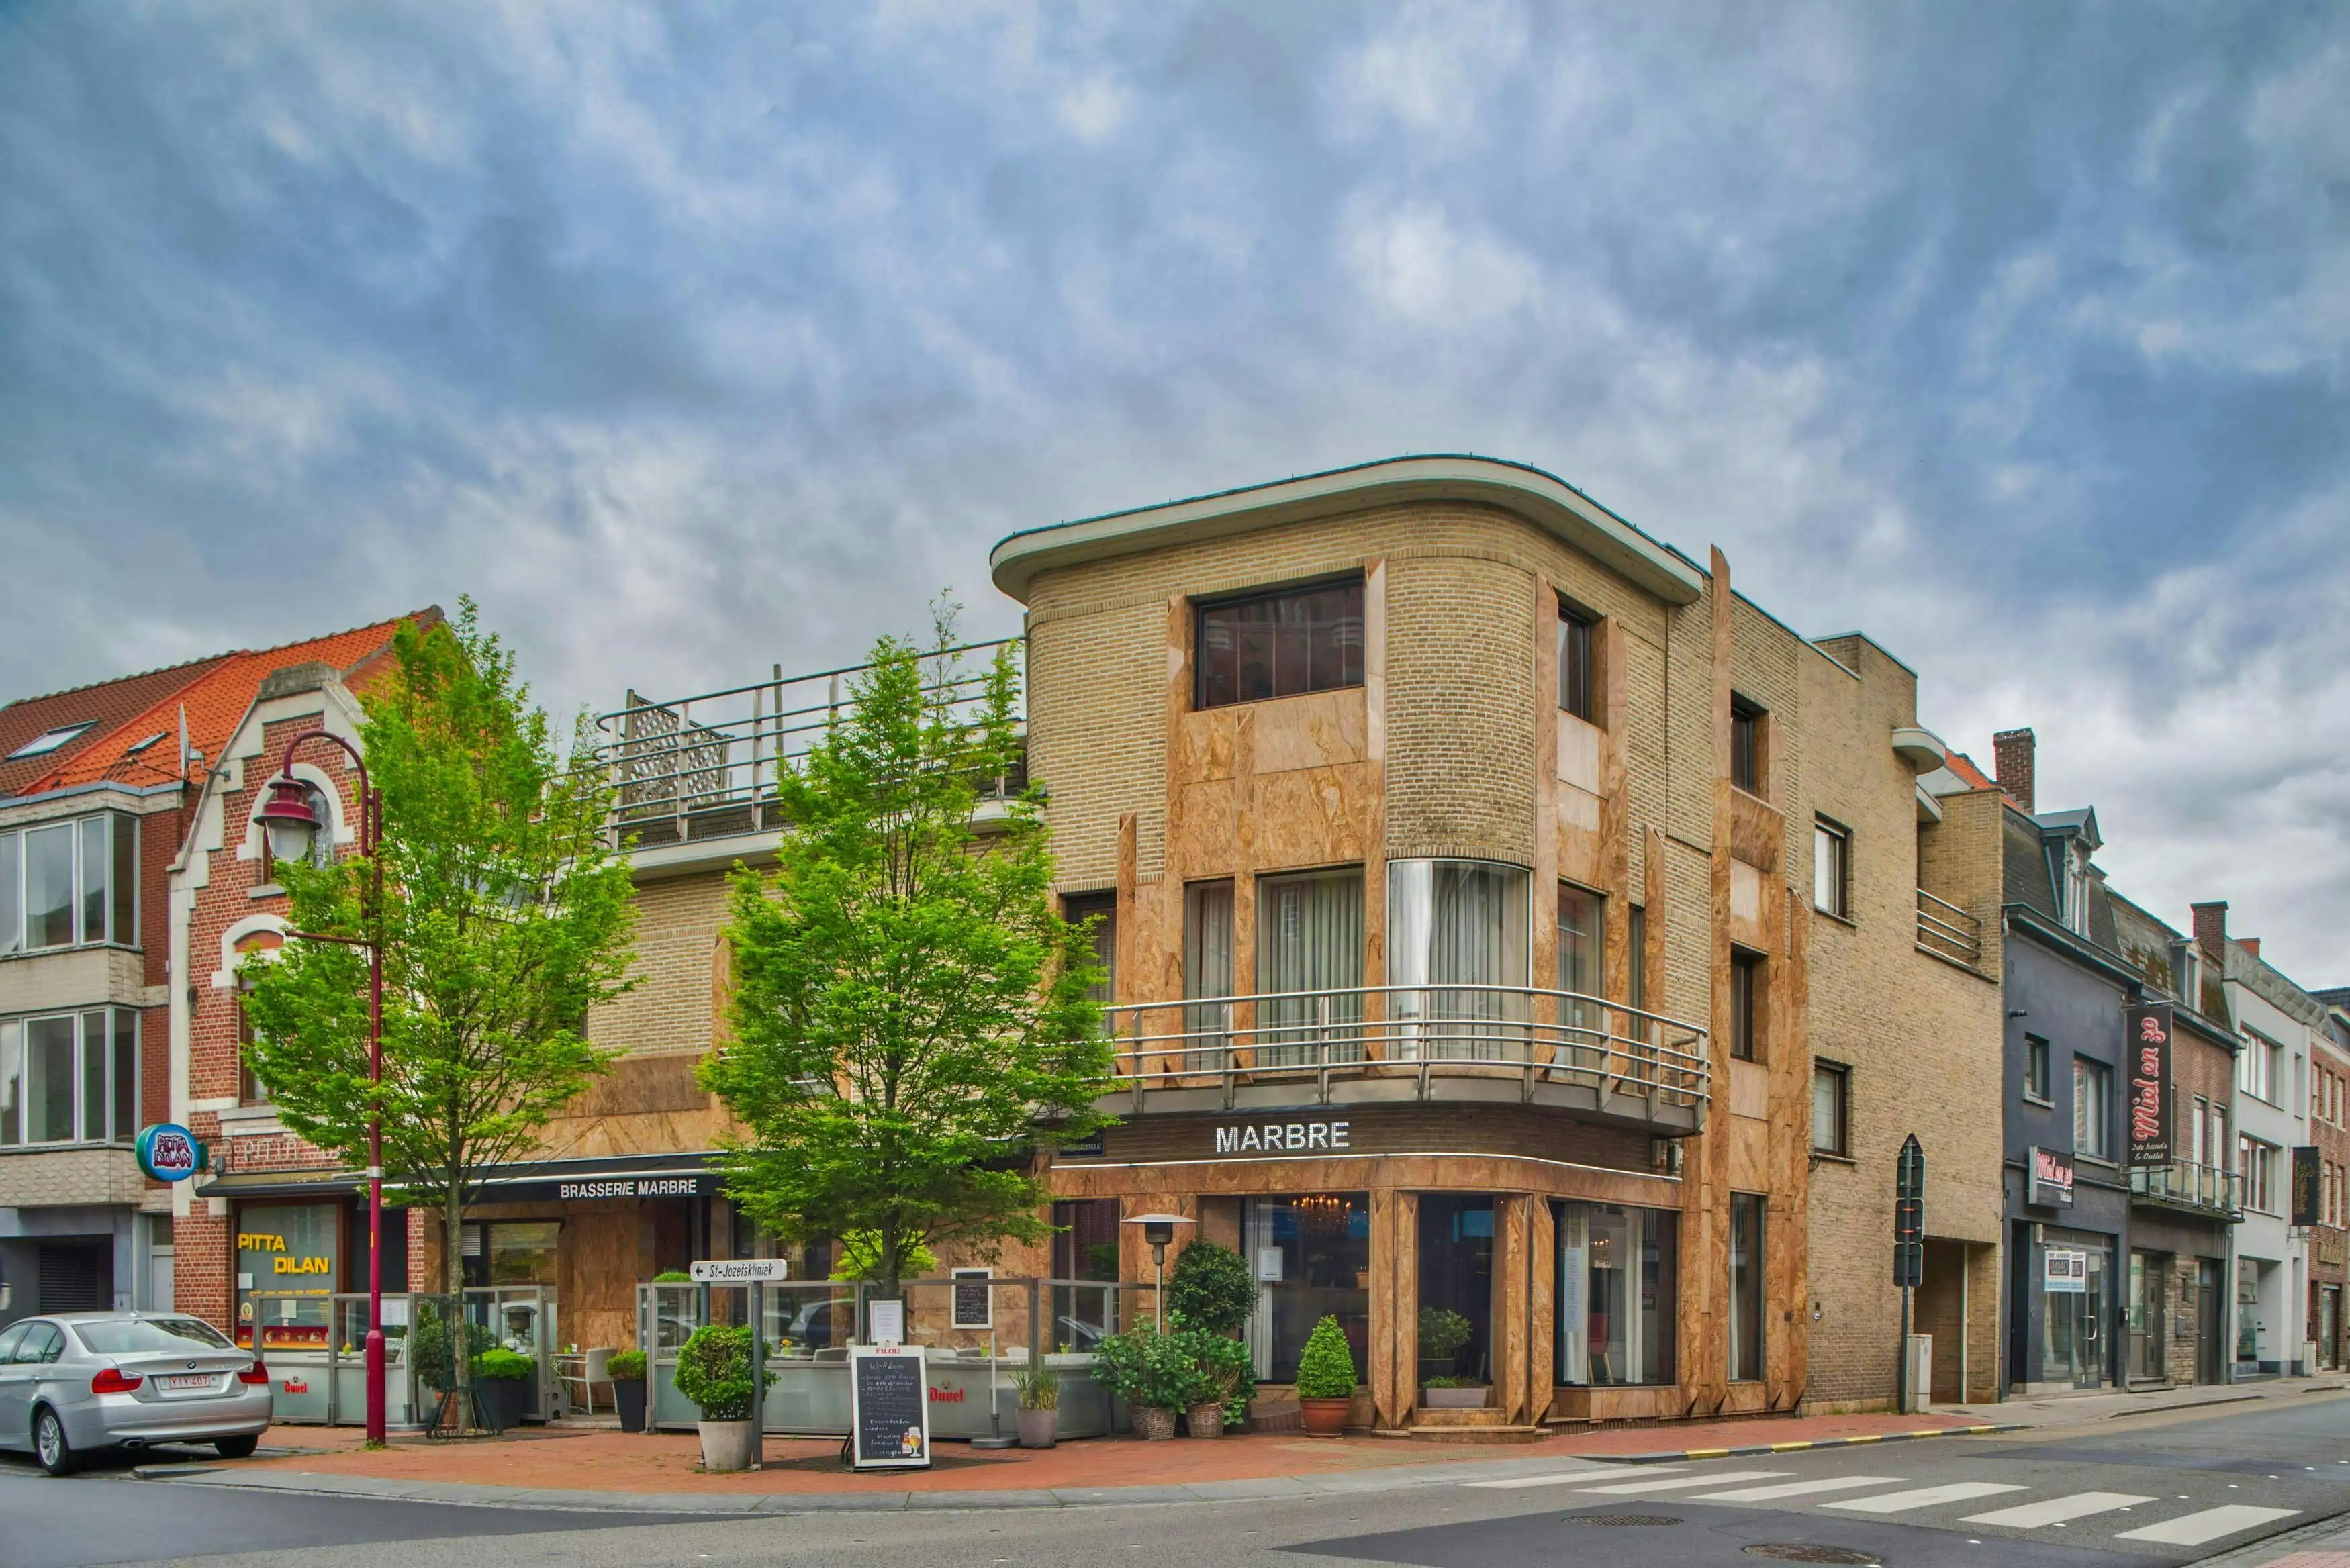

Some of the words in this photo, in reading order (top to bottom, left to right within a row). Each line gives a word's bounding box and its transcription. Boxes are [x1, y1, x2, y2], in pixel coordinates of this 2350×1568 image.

[157, 1134, 189, 1153] PITTA
[1216, 1121, 1350, 1153] MARBRE
[153, 1149, 193, 1168] DILAN
[560, 1181, 634, 1199] BRASSERIE
[637, 1179, 697, 1195] MARBRE
[238, 1233, 287, 1252] PITTA
[274, 1256, 329, 1273] DILAN
[710, 1263, 773, 1278] St-Jozefskliniek
[929, 1386, 964, 1403] Duvel
